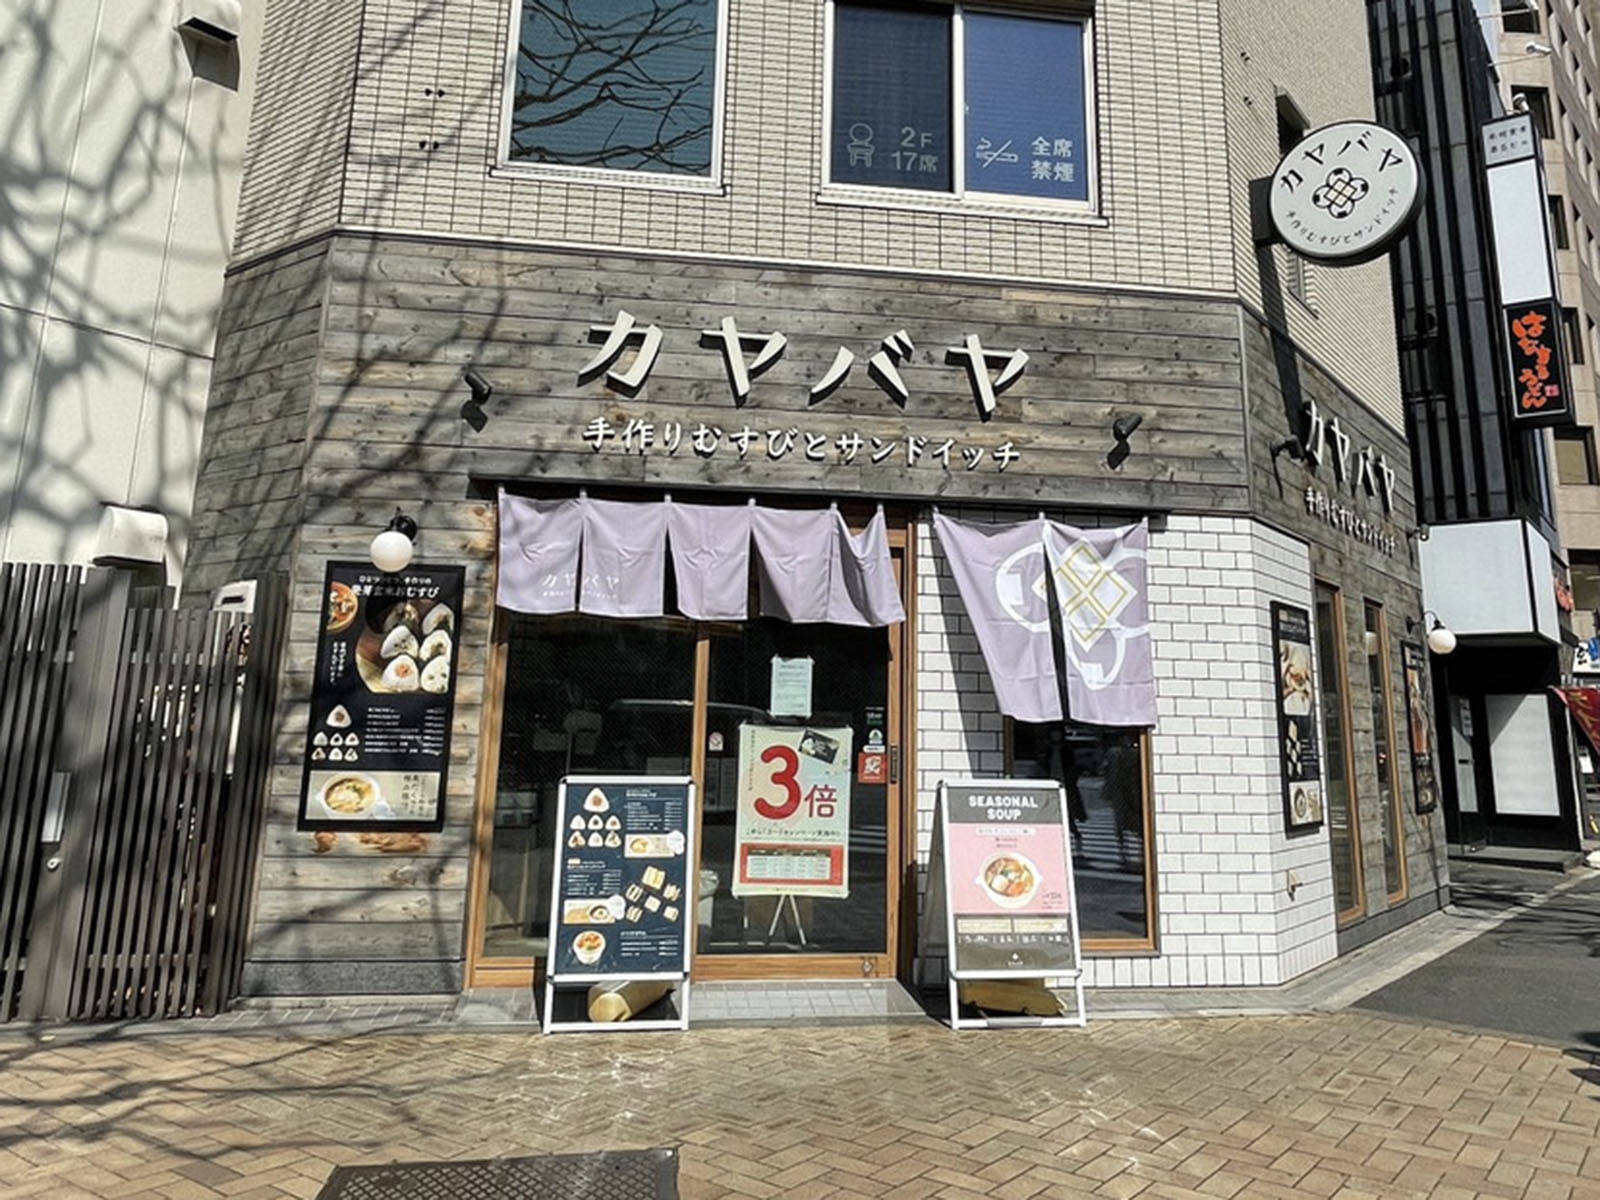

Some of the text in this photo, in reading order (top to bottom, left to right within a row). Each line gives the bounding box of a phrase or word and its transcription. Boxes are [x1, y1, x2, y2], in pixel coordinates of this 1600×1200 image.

[900, 126, 932, 147] 2F
[1031, 136, 1073, 157] 全席
[891, 152, 938, 172] 17席
[1031, 160, 1075, 182] 禁煙
[1280, 130, 1403, 193] カヤバヤ
[578, 309, 1030, 415] カヤバヤ
[582, 416, 1021, 471] 手作りむすびとサンドイッチ
[1305, 400, 1395, 513] カヤバヤ
[968, 795, 1038, 808] SEASONAL
[986, 808, 1022, 821] SOUP
